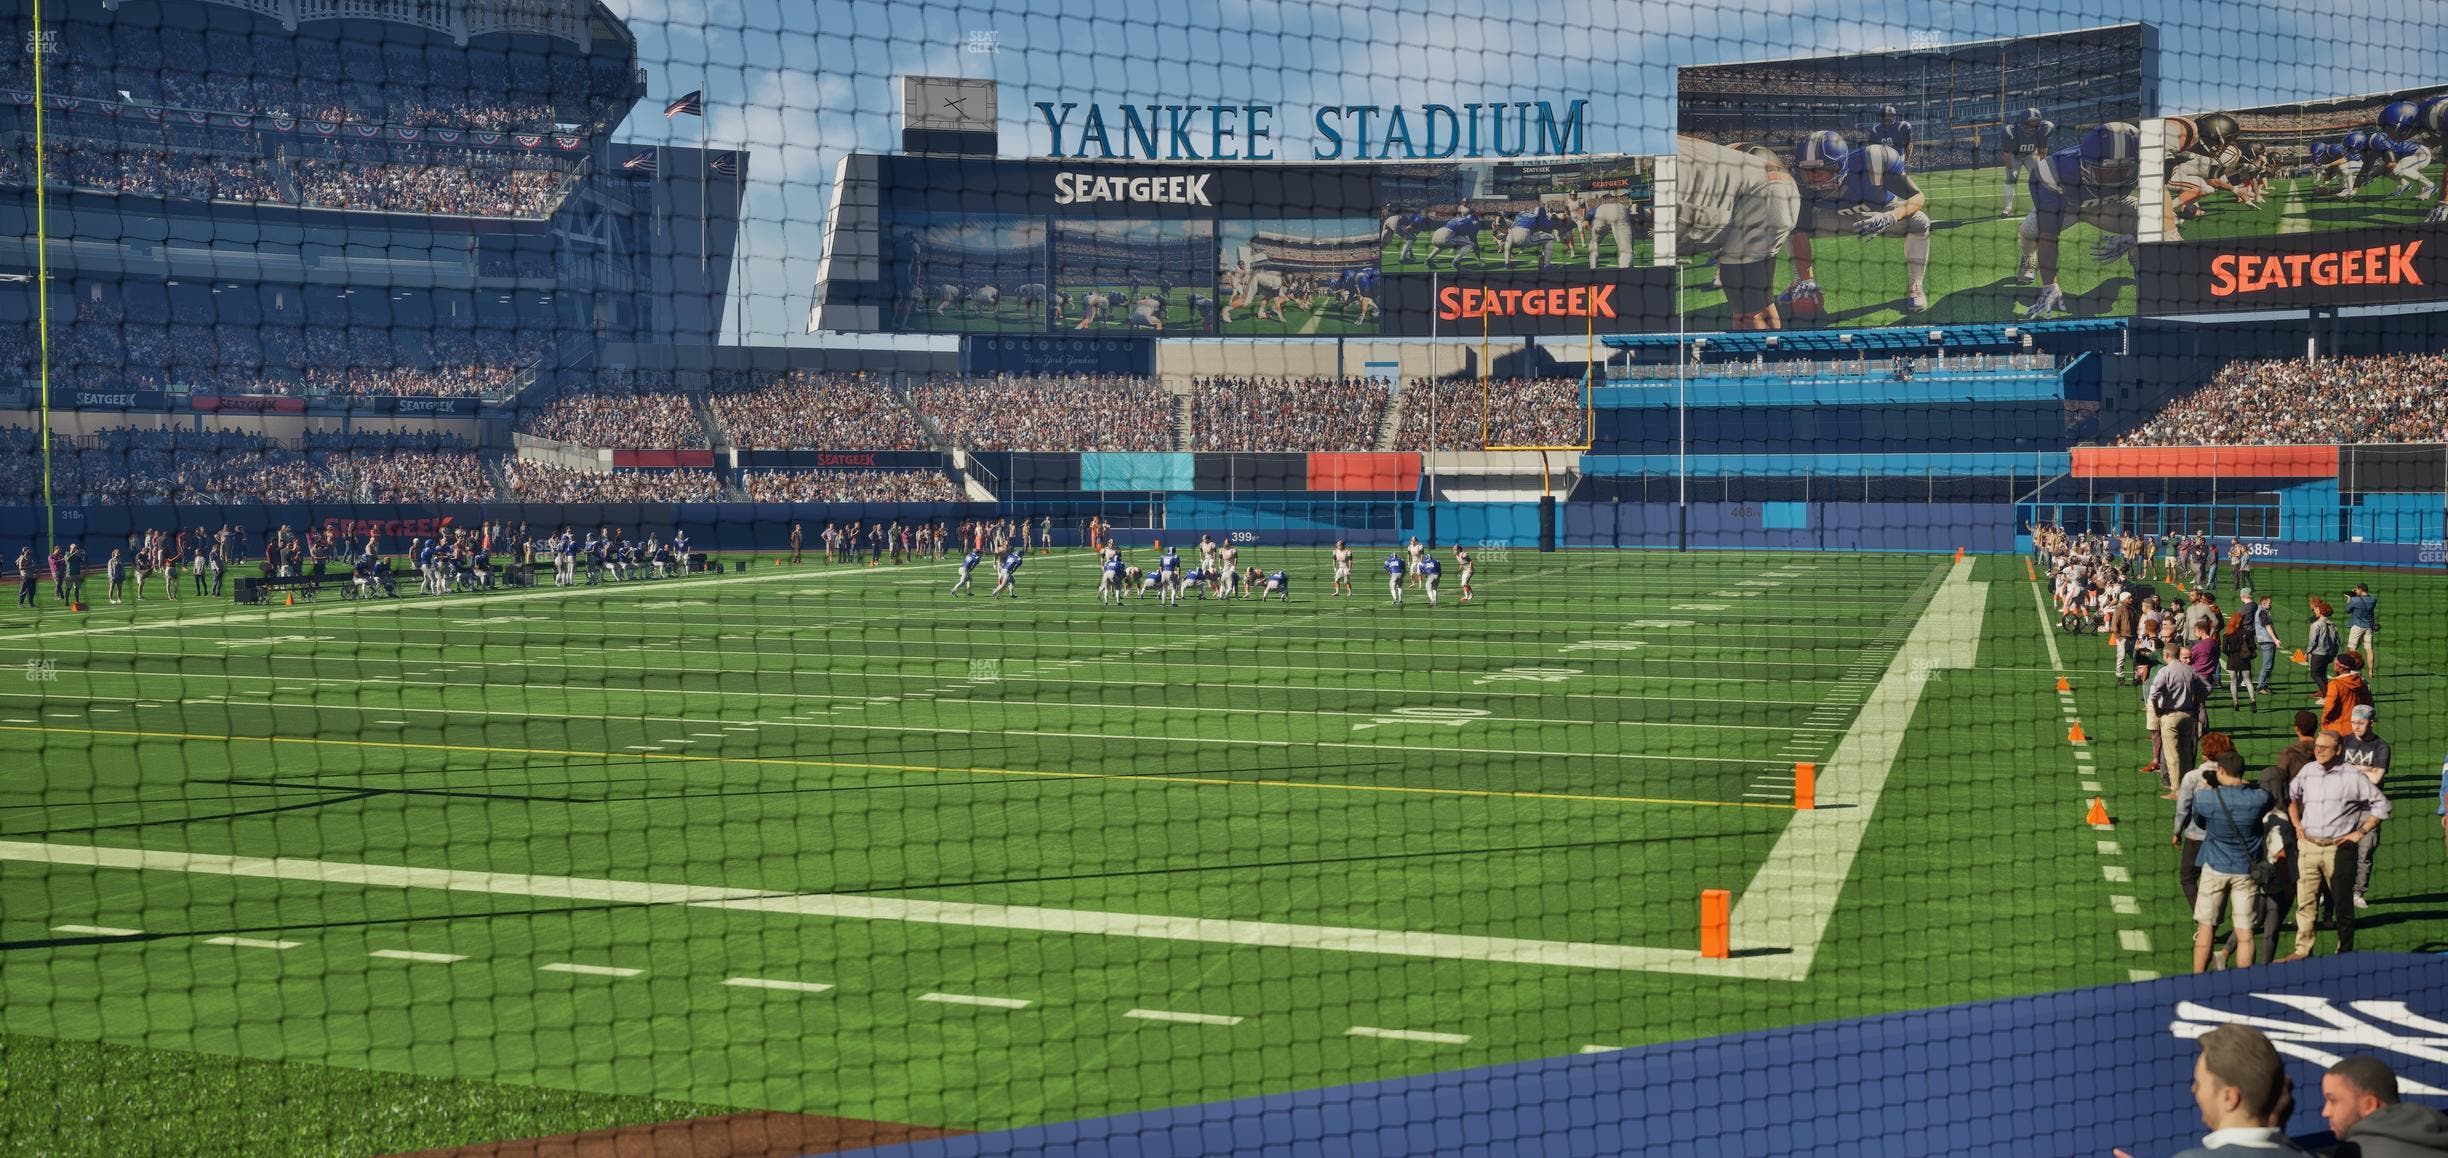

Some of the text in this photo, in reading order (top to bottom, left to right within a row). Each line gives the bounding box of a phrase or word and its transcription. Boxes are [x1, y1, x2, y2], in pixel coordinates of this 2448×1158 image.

[1034, 99, 1588, 160] YANKEE STADIUM
[1055, 172, 1212, 207] SEATGEEK
[2211, 240, 2424, 297] SEATGEEK
[1439, 285, 1617, 320] SEATGEEK
[76, 393, 136, 406] SEATGEEK
[400, 400, 455, 412] SEATGEEK
[817, 453, 875, 466] SEATGEEK
